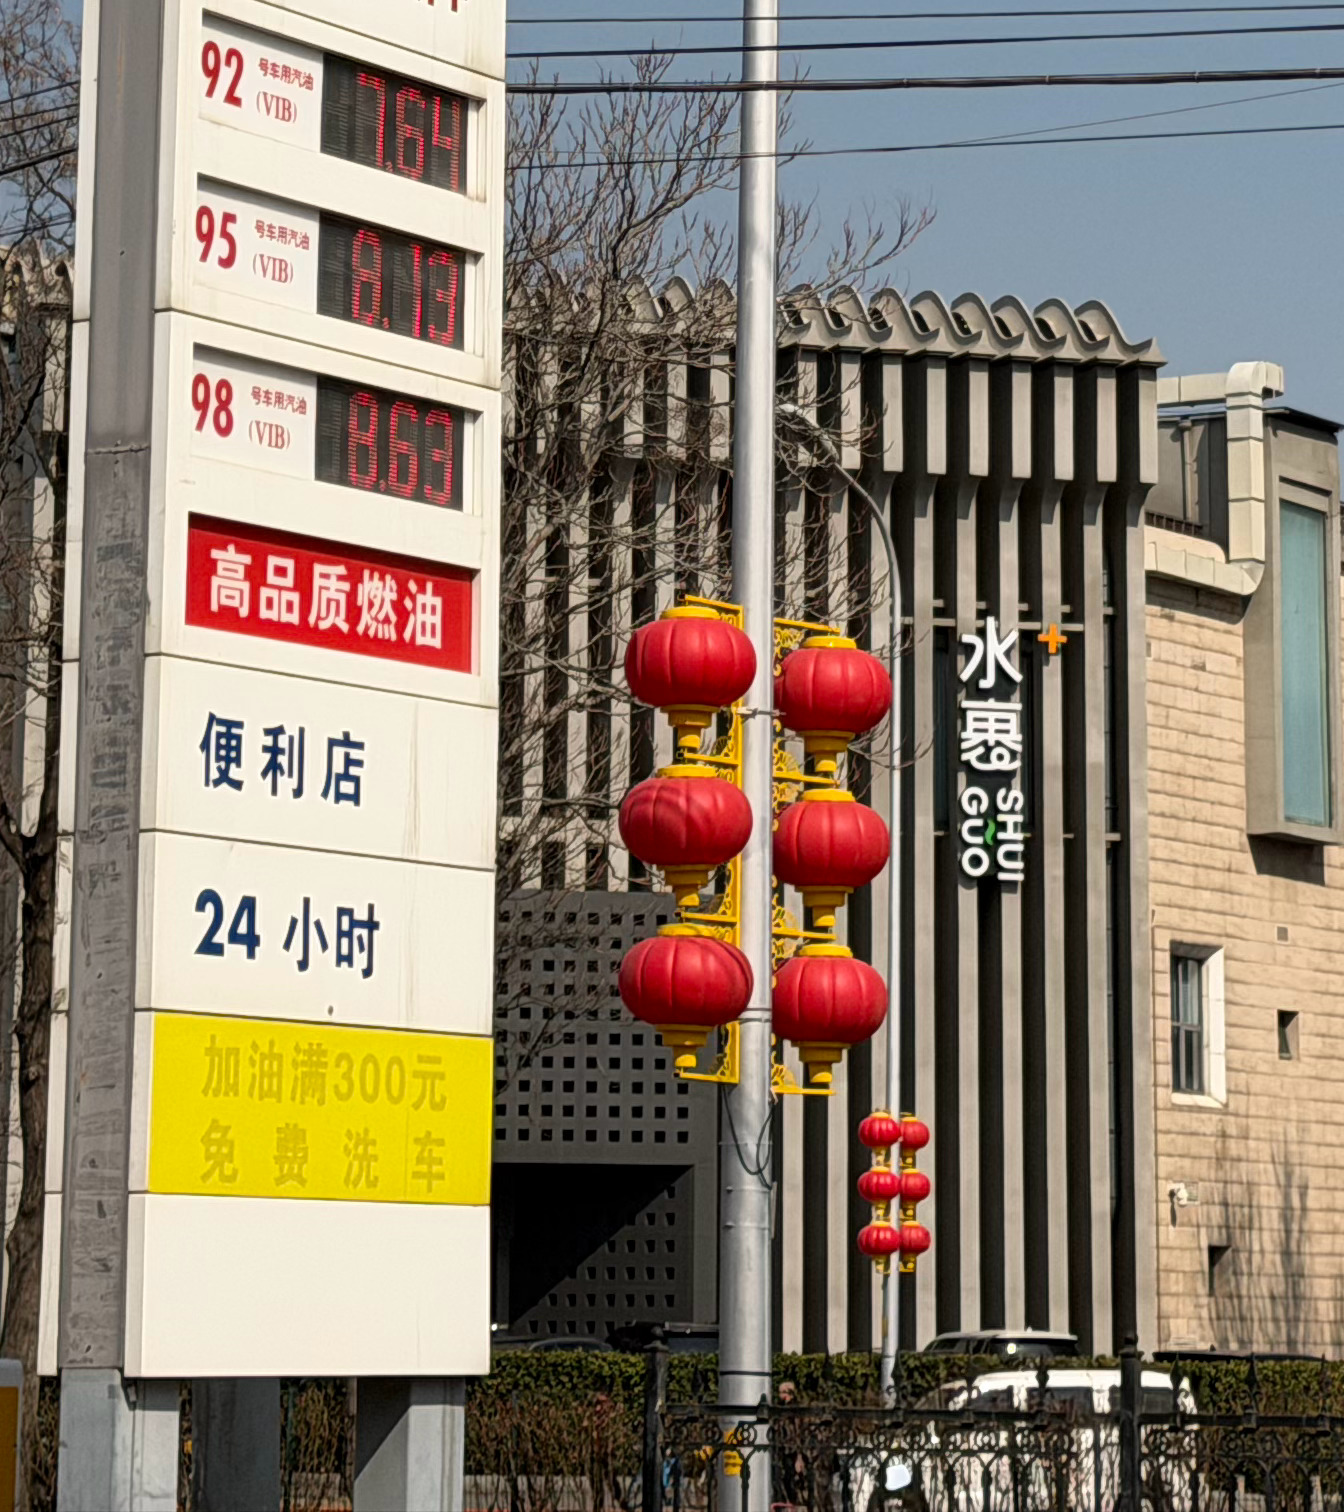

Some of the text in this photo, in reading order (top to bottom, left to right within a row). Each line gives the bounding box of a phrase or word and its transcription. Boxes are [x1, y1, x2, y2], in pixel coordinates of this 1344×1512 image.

[201, 41, 244, 108] 92
[256, 91, 297, 123] (VIB)
[258, 57, 314, 91] 号车用汽油
[355, 72, 459, 192] 7.64
[195, 205, 237, 269] 95
[252, 253, 294, 284] (VIB)
[255, 219, 310, 251] 号车用汽油
[352, 229, 458, 346] 8.13
[191, 372, 234, 438] 98
[250, 385, 307, 416] 号车用汽油
[248, 419, 291, 450] (VIB)
[348, 391, 453, 506] 8.63
[209, 543, 444, 650] 高品质燃油
[199, 712, 365, 807] 便利店
[961, 786, 989, 877] GUO
[996, 788, 1024, 882] SHUI
[201, 1033, 448, 1113] 加油满300元
